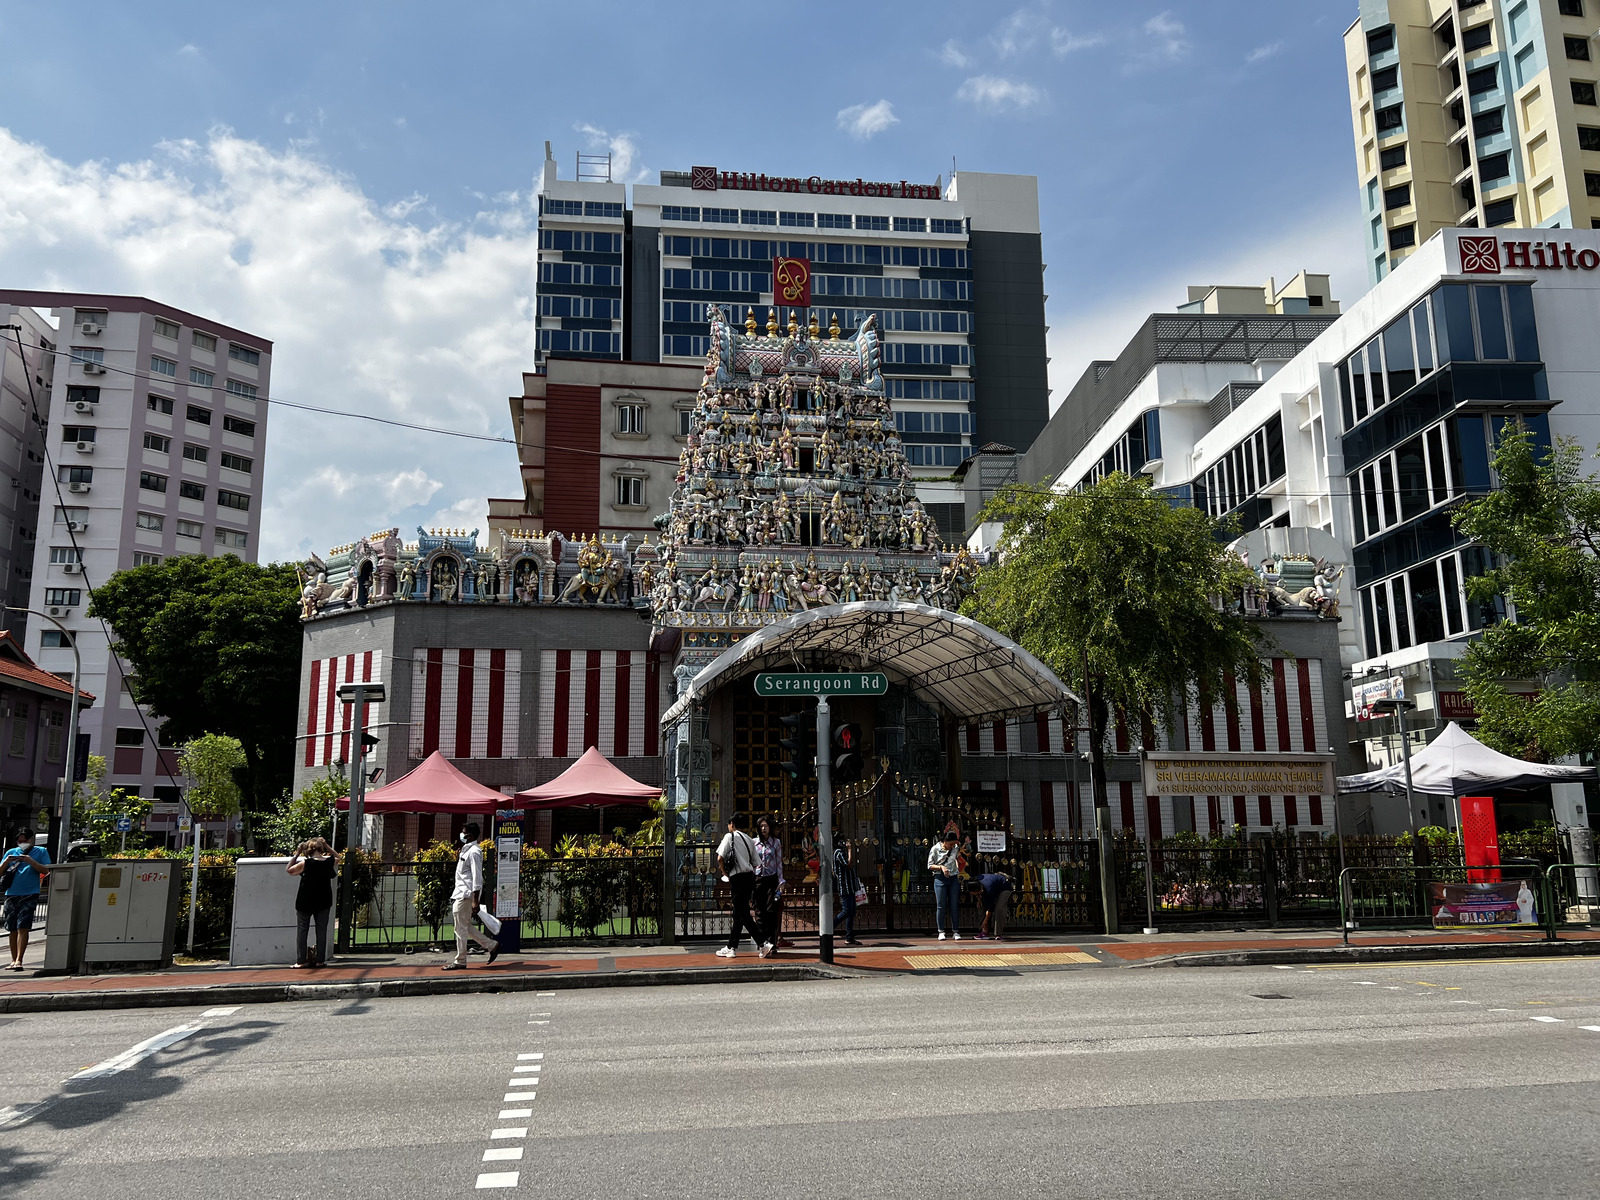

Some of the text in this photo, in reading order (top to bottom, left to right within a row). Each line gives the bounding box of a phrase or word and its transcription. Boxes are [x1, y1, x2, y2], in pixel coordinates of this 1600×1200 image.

[720, 171, 941, 200] Hilton Garden Inn
[765, 676, 879, 693] Serangoon Rd
[1157, 772, 1323, 781] SRI VEERAMAKALIAMMAN TEMPLE
[1157, 785, 1169, 793] 141
[1172, 785, 1223, 793] SERANGOON
[1225, 785, 1249, 793] ROAD,
[1251, 785, 1297, 793] SINGAPORE
[499, 826, 520, 834] INDIA
